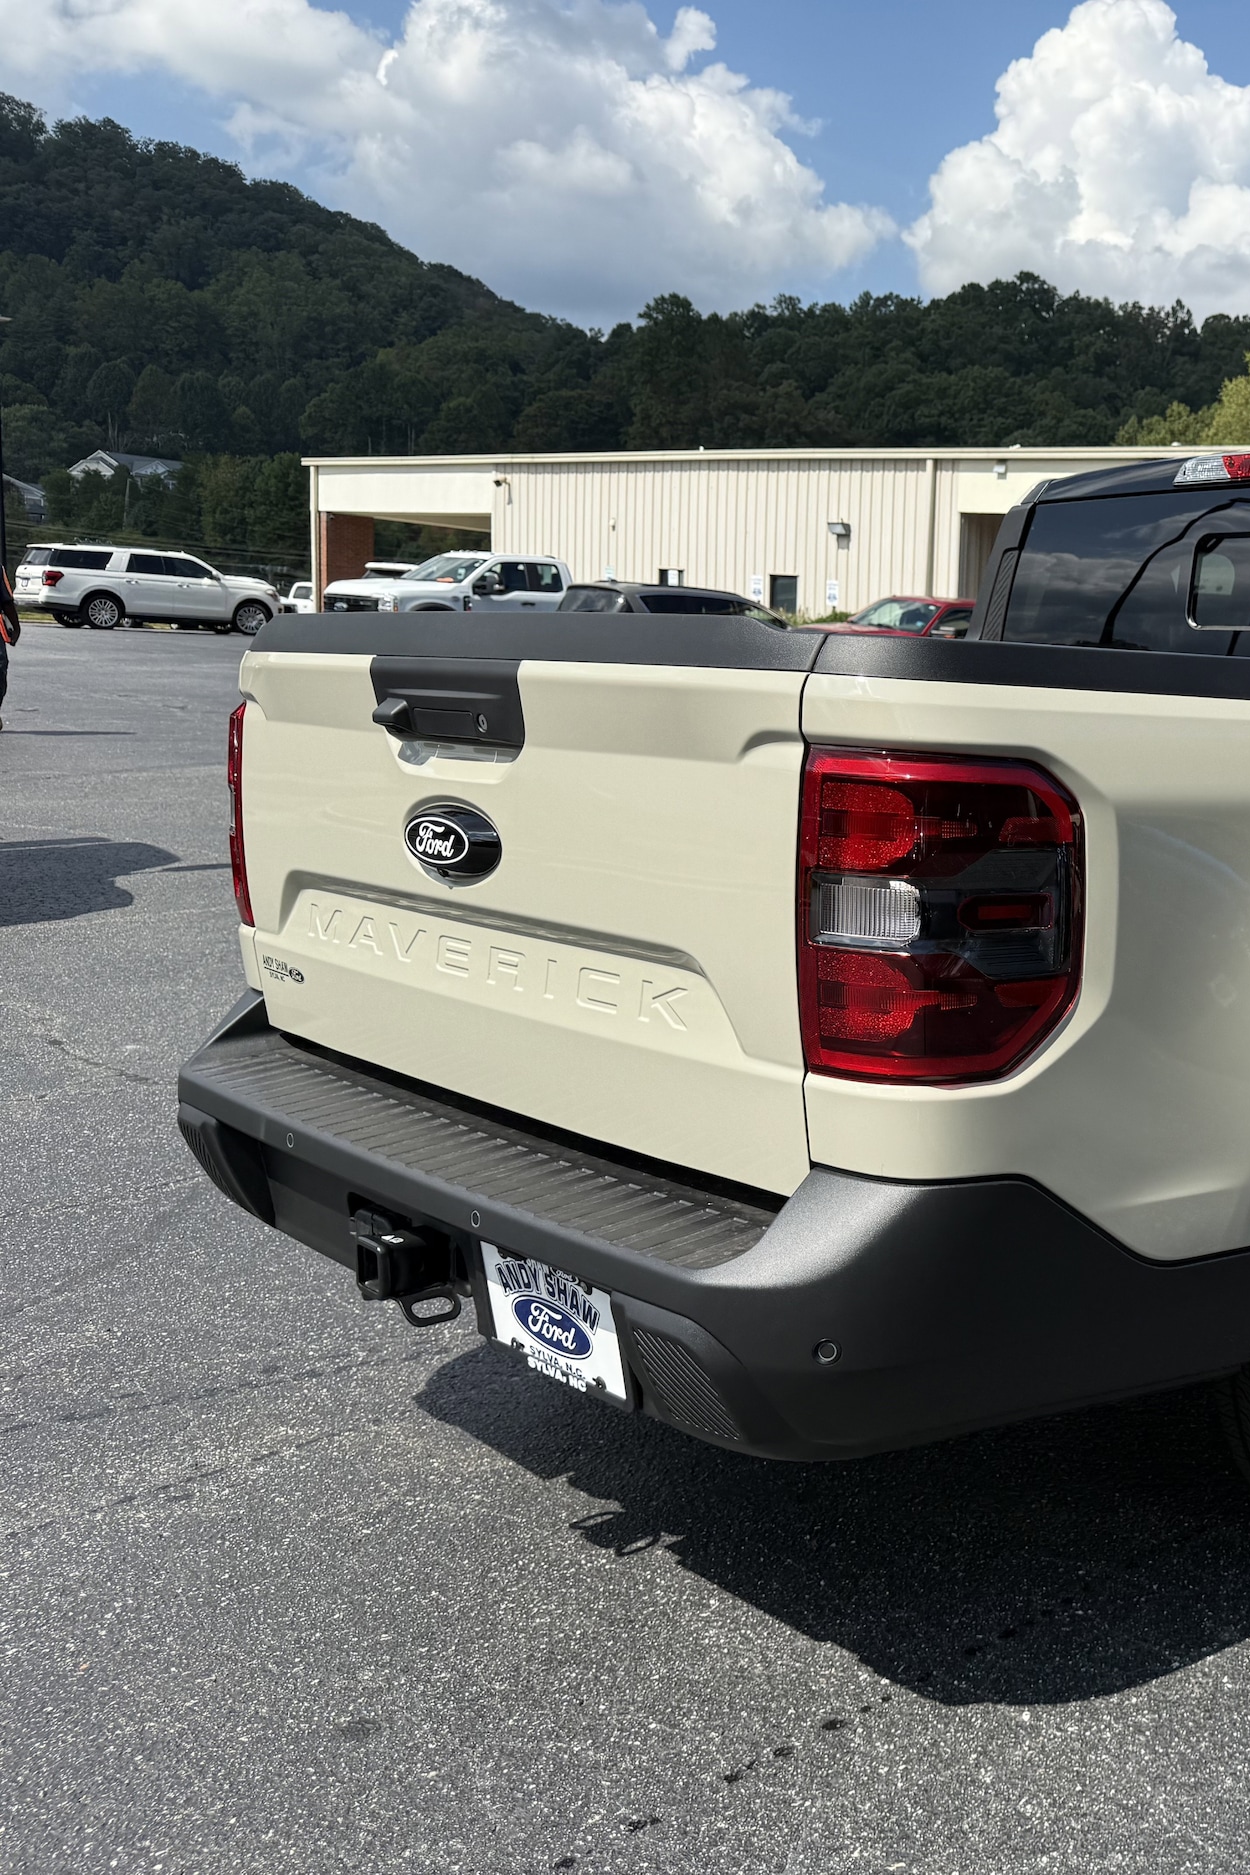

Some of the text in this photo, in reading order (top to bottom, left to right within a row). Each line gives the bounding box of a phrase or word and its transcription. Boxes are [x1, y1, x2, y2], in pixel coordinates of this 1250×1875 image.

[415, 820, 455, 859] Ford
[307, 903, 689, 1032] MAVERICK
[494, 1259, 600, 1336] ANDY SHAW
[527, 1302, 578, 1350] Ford
